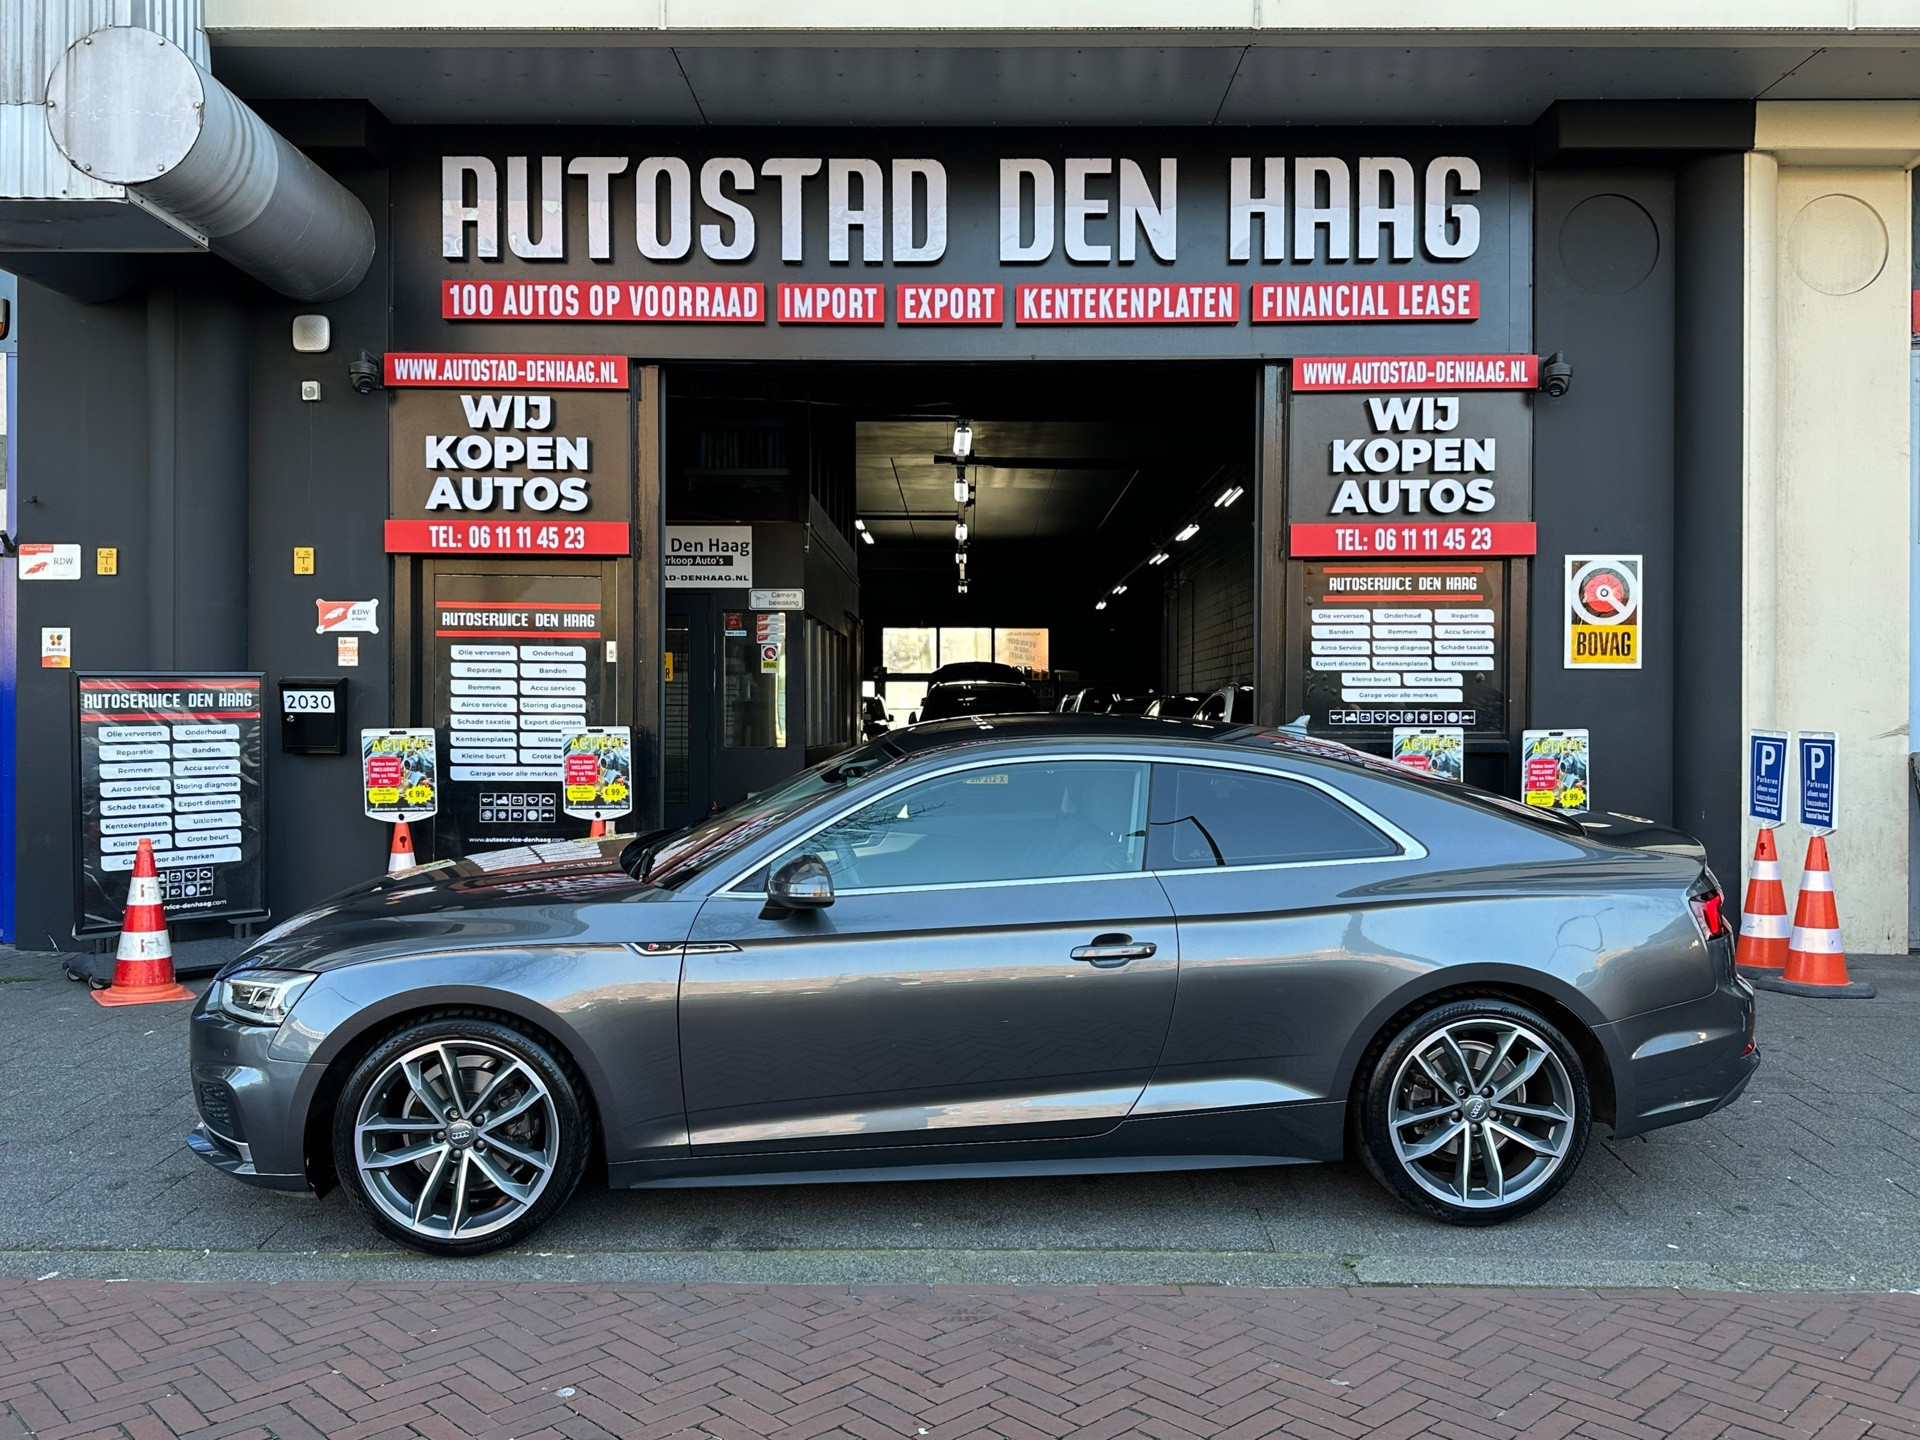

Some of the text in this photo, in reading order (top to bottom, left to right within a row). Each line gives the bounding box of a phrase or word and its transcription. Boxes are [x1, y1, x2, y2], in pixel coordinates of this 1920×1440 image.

[442, 155, 1481, 262] AUTOSTAD DEN HAAG
[450, 284, 757, 318] 100 AUTOS OP VOORRAAD
[784, 287, 877, 318] IMPORT
[905, 288, 995, 319] EXPORT
[1023, 286, 1233, 319] KENTEKENPLATEN
[1262, 284, 1470, 318] FINANCIAL LEASE
[395, 359, 618, 383] WWW.AUTOSTAD-DENHAAG.NL
[1303, 361, 1528, 384] WWW.AUTOSTAD-DENHAAG.NL
[460, 395, 550, 429] WIJ
[1368, 397, 1459, 431] WIJ
[425, 435, 588, 470] KOPEN
[1333, 438, 1495, 472] KOPEN
[425, 477, 588, 511] AUTOS
[1331, 478, 1495, 513] AUTOS
[430, 526, 584, 548] TEL: 06 11 11 45 23
[671, 538, 750, 556] Den Haag
[1336, 528, 1491, 551] TEL: 06 11 11 45 23
[695, 557, 723, 565] Auto's
[1419, 577, 1441, 590] DEN
[1446, 577, 1477, 590] HAAG
[535, 614, 558, 627] DEN
[564, 614, 595, 627] HAAG
[1577, 632, 1631, 656] BOVAG
[1377, 660, 1428, 668] Kentekenplaten
[189, 693, 213, 707] DEN
[219, 693, 252, 707] HAAG
[287, 695, 331, 709] 2030
[1761, 745, 1775, 776] P
[1811, 748, 1825, 780] P
[106, 821, 167, 830] Kentekenplaten
